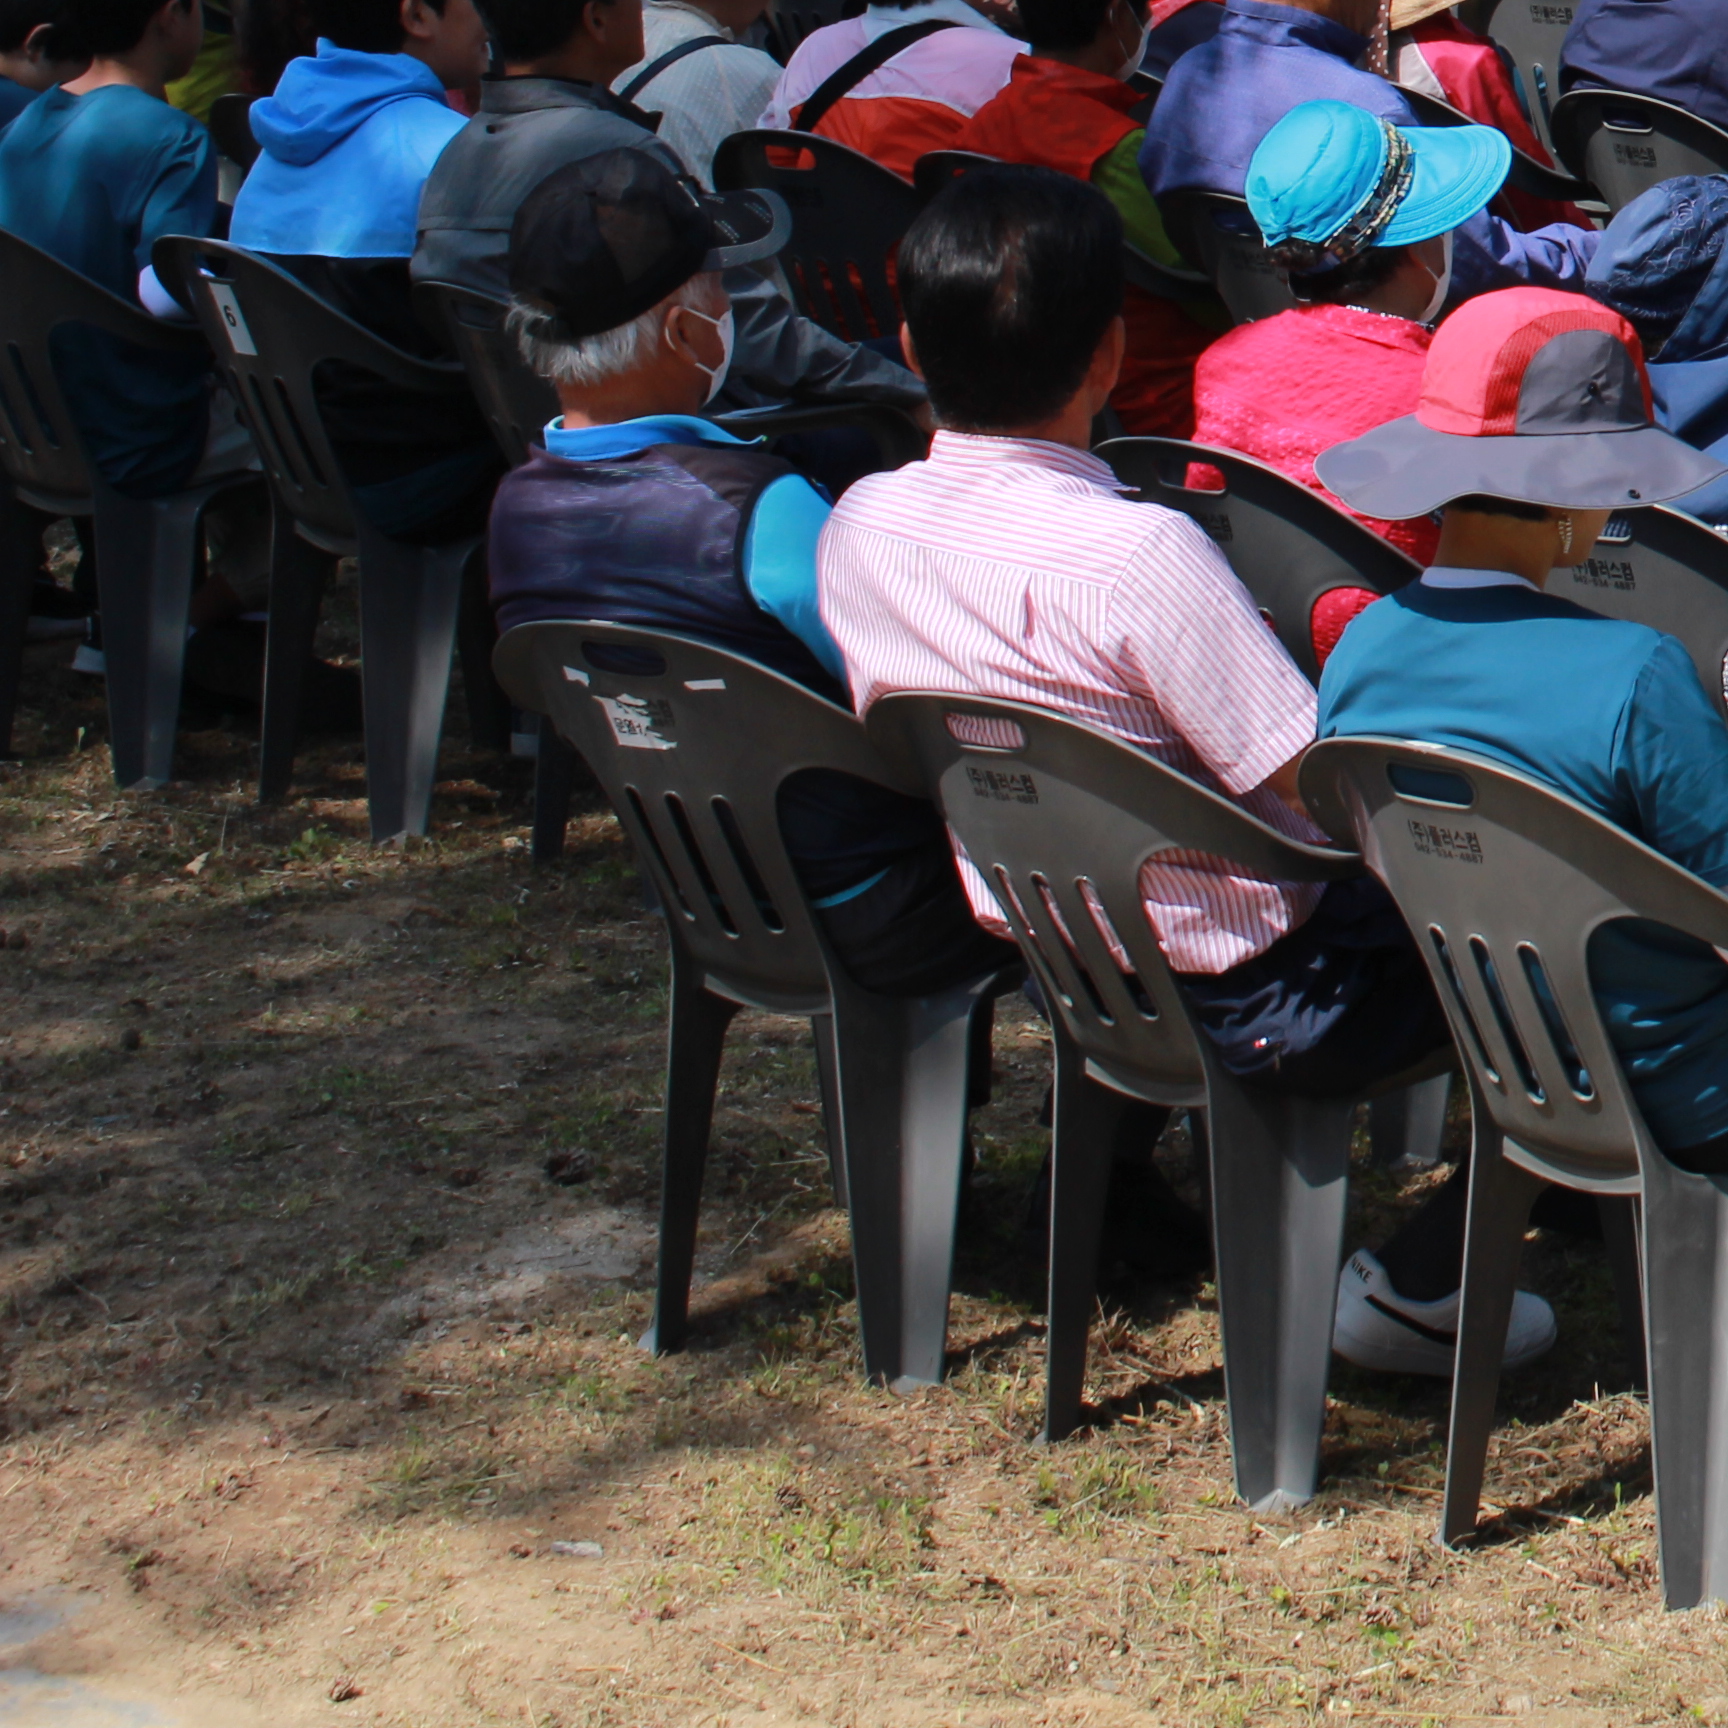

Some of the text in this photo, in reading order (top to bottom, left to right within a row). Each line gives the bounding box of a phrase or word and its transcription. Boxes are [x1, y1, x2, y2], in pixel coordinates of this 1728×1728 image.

[223, 305, 237, 327] 6
[966, 766, 1037, 795] (주)플러스컴
[1407, 818, 1482, 853] (주)플러스컴
[1350, 1256, 1374, 1284] NIKE
